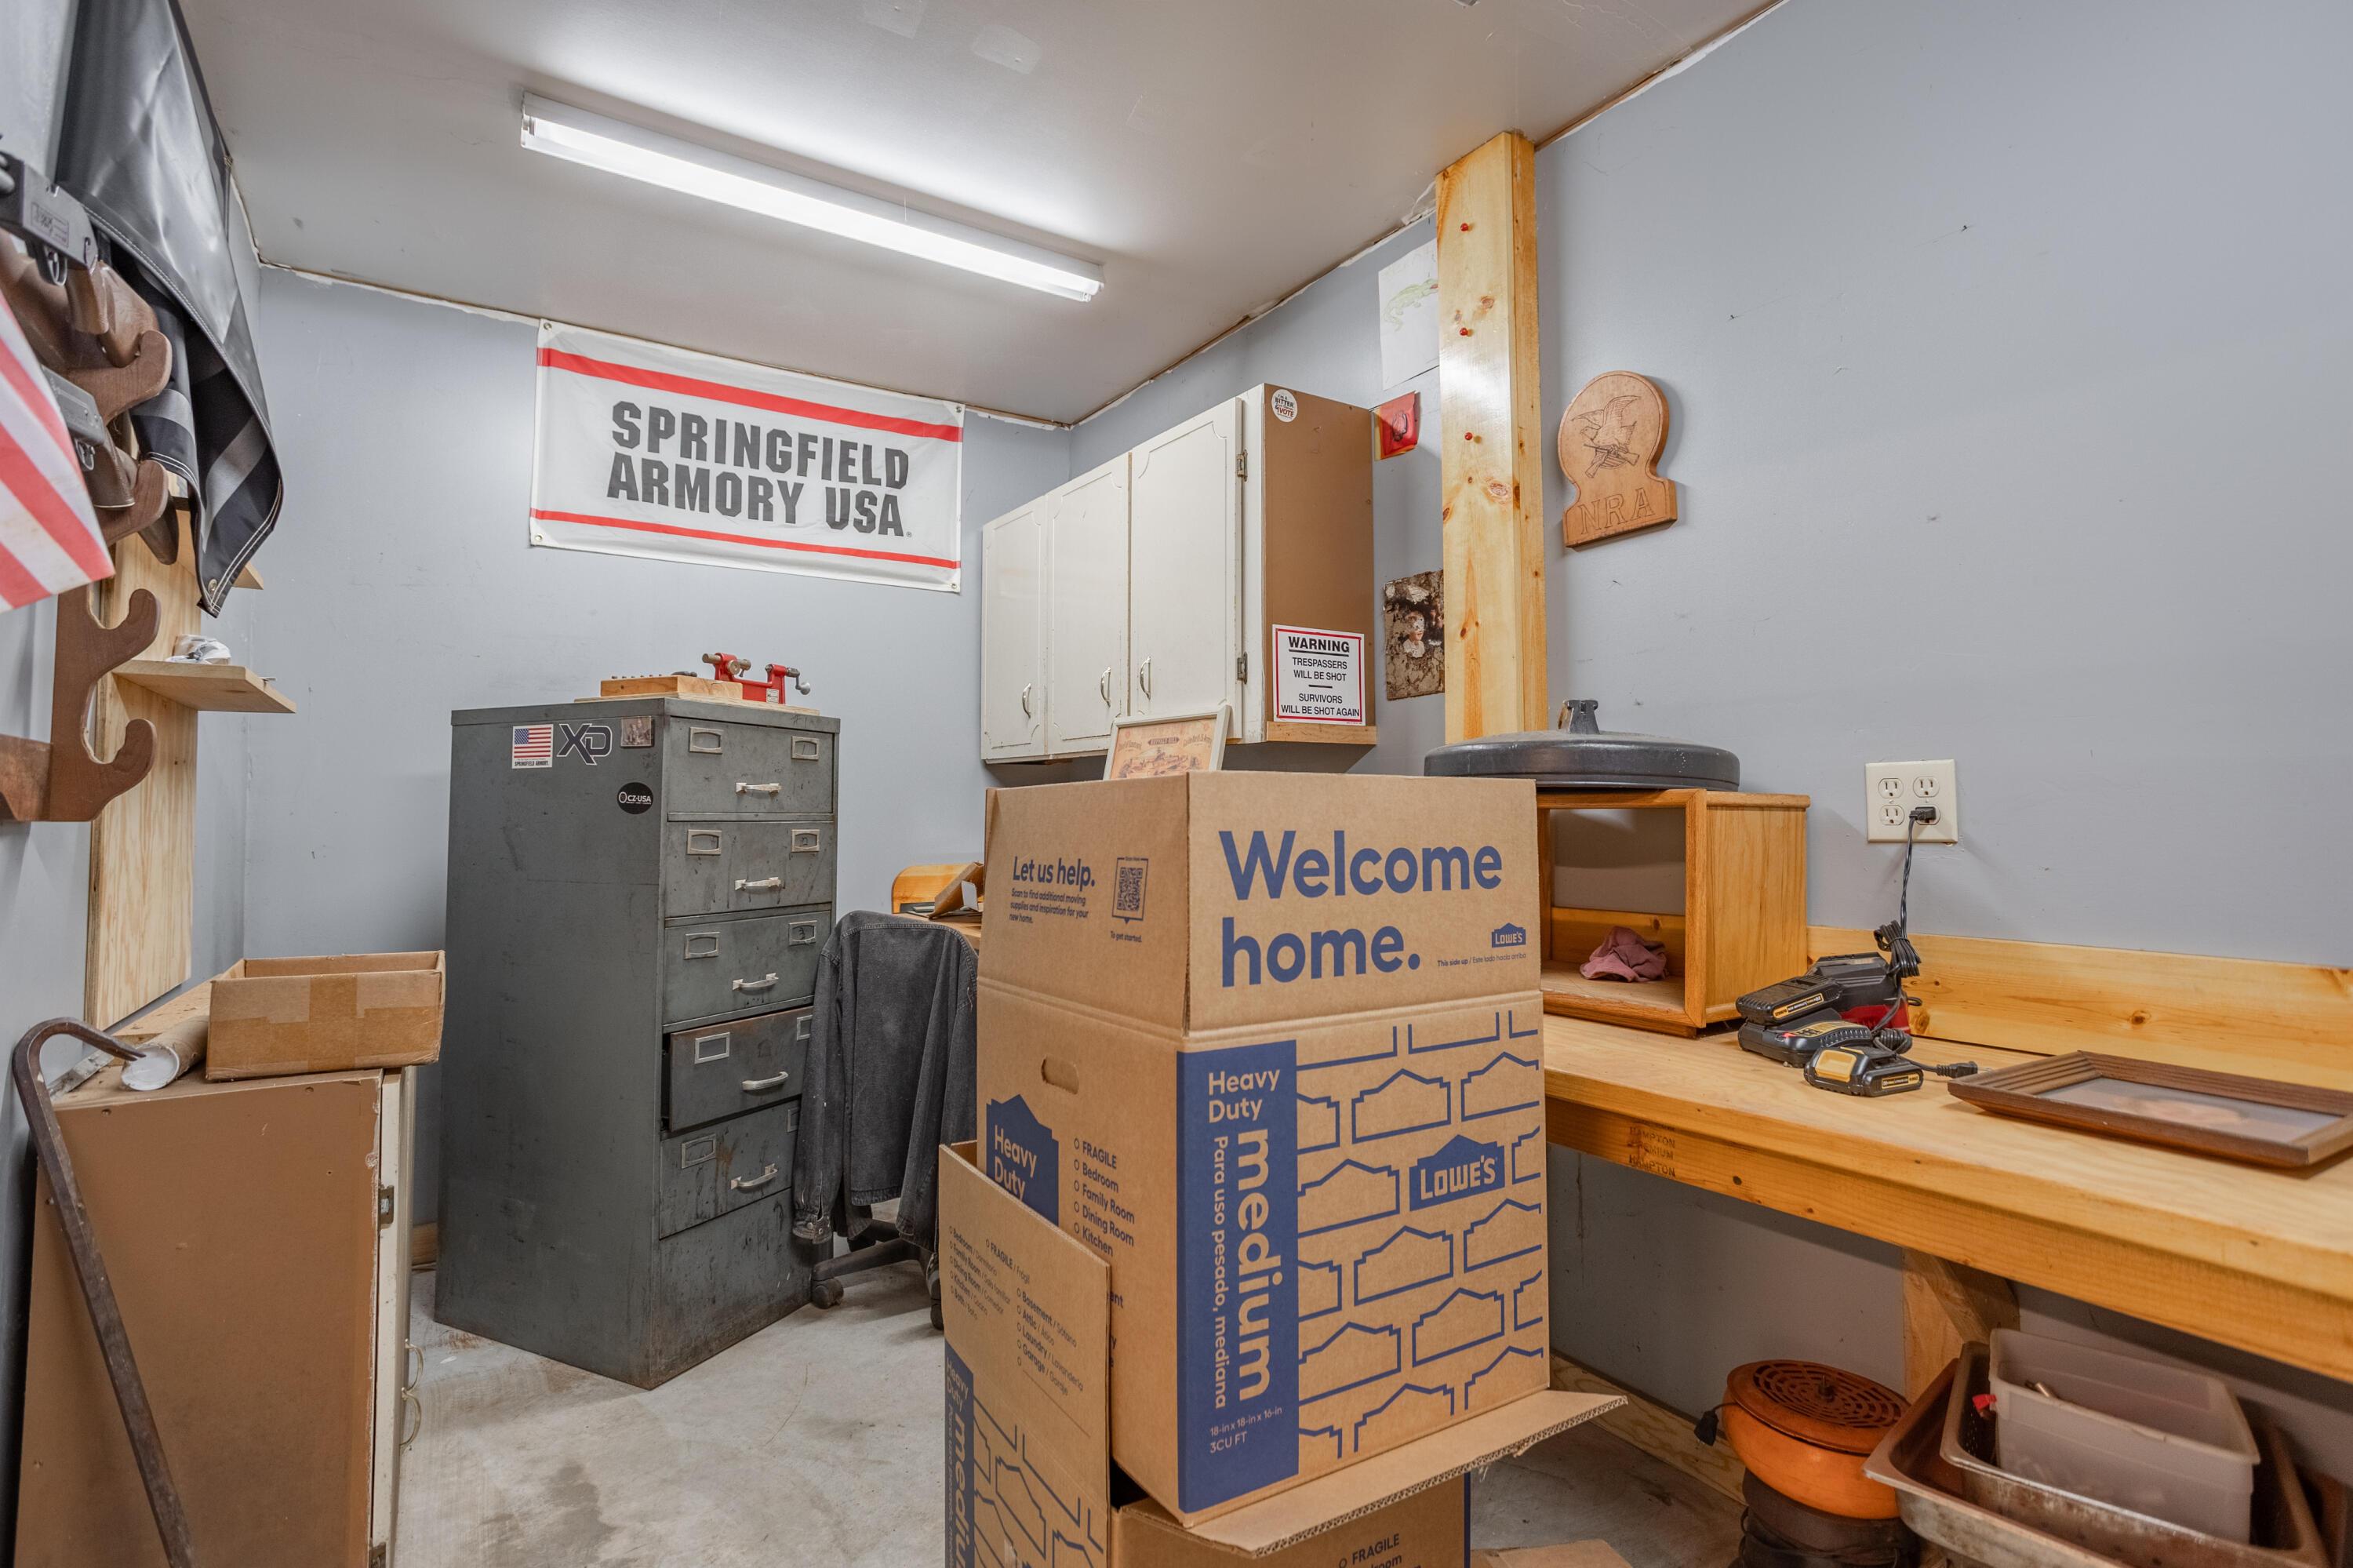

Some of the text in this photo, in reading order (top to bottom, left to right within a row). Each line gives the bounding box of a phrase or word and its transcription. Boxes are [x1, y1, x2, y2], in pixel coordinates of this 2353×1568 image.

[612, 401, 909, 489] SPRINGFIELD
[607, 452, 805, 525] ARMORY
[1577, 487, 1656, 535] NRA
[1288, 636, 1350, 653] WARNING
[1293, 657, 1347, 670] TRESPASSERS
[1293, 670, 1312, 679] WILL
[1326, 673, 1347, 682] SHOT
[1281, 704, 1300, 714] WILL
[1336, 708, 1360, 717] AGAIN
[1299, 693, 1343, 704] SURVIVORS
[556, 723, 613, 766] XD
[1013, 856, 1095, 892] Let us help.
[1218, 831, 1502, 900] Welcome
[1010, 900, 1028, 911] supplies
[1029, 903, 1038, 911] and
[1039, 904, 1066, 916] inspiration
[1075, 909, 1089, 919] your
[1011, 888, 1023, 898] Scan
[1029, 890, 1038, 900] find
[1039, 891, 1065, 903] additional
[1065, 894, 1086, 907] moving
[1009, 913, 1019, 922] new
[1222, 917, 1420, 988] home.
[1495, 932, 1522, 944] LOWE'S
[1209, 1069, 1280, 1096] Heavy
[1209, 1097, 1263, 1123] Duty
[995, 1125, 1037, 1178] Heavy
[1082, 1141, 1117, 1170] FRAGILE
[995, 1155, 1025, 1202] Duty
[1082, 1162, 1119, 1193] Bedroom
[1420, 1155, 1496, 1200] LOWE'S
[1082, 1184, 1135, 1224] Family Room
[1082, 1205, 1134, 1246] Dining Room
[1082, 1225, 1114, 1257] Kitchen
[954, 1243, 968, 1266] Family
[968, 1257, 981, 1279] Room
[991, 1242, 1013, 1270] FRAGILE
[1212, 1136, 1230, 1409] Para uso pesado, mediana
[1238, 1129, 1283, 1401] medium
[954, 1258, 968, 1282] Dining
[968, 1272, 981, 1293] Room
[955, 1273, 971, 1298] Kitchen
[1023, 1290, 1052, 1326] Basement
[1023, 1308, 1037, 1330] Attic
[1023, 1324, 1047, 1359] Laundry
[1023, 1343, 1045, 1374] Garage
[947, 1356, 969, 1400] Heavy
[947, 1375, 963, 1413] Duty
[1210, 1424, 1229, 1437] 18-in
[1237, 1415, 1256, 1428] 18-in
[1264, 1406, 1282, 1419] 16-in
[1210, 1431, 1247, 1454] 3CU FT
[955, 1412, 970, 1568] mediu
[1352, 1533, 1399, 1565] FRAGILE
